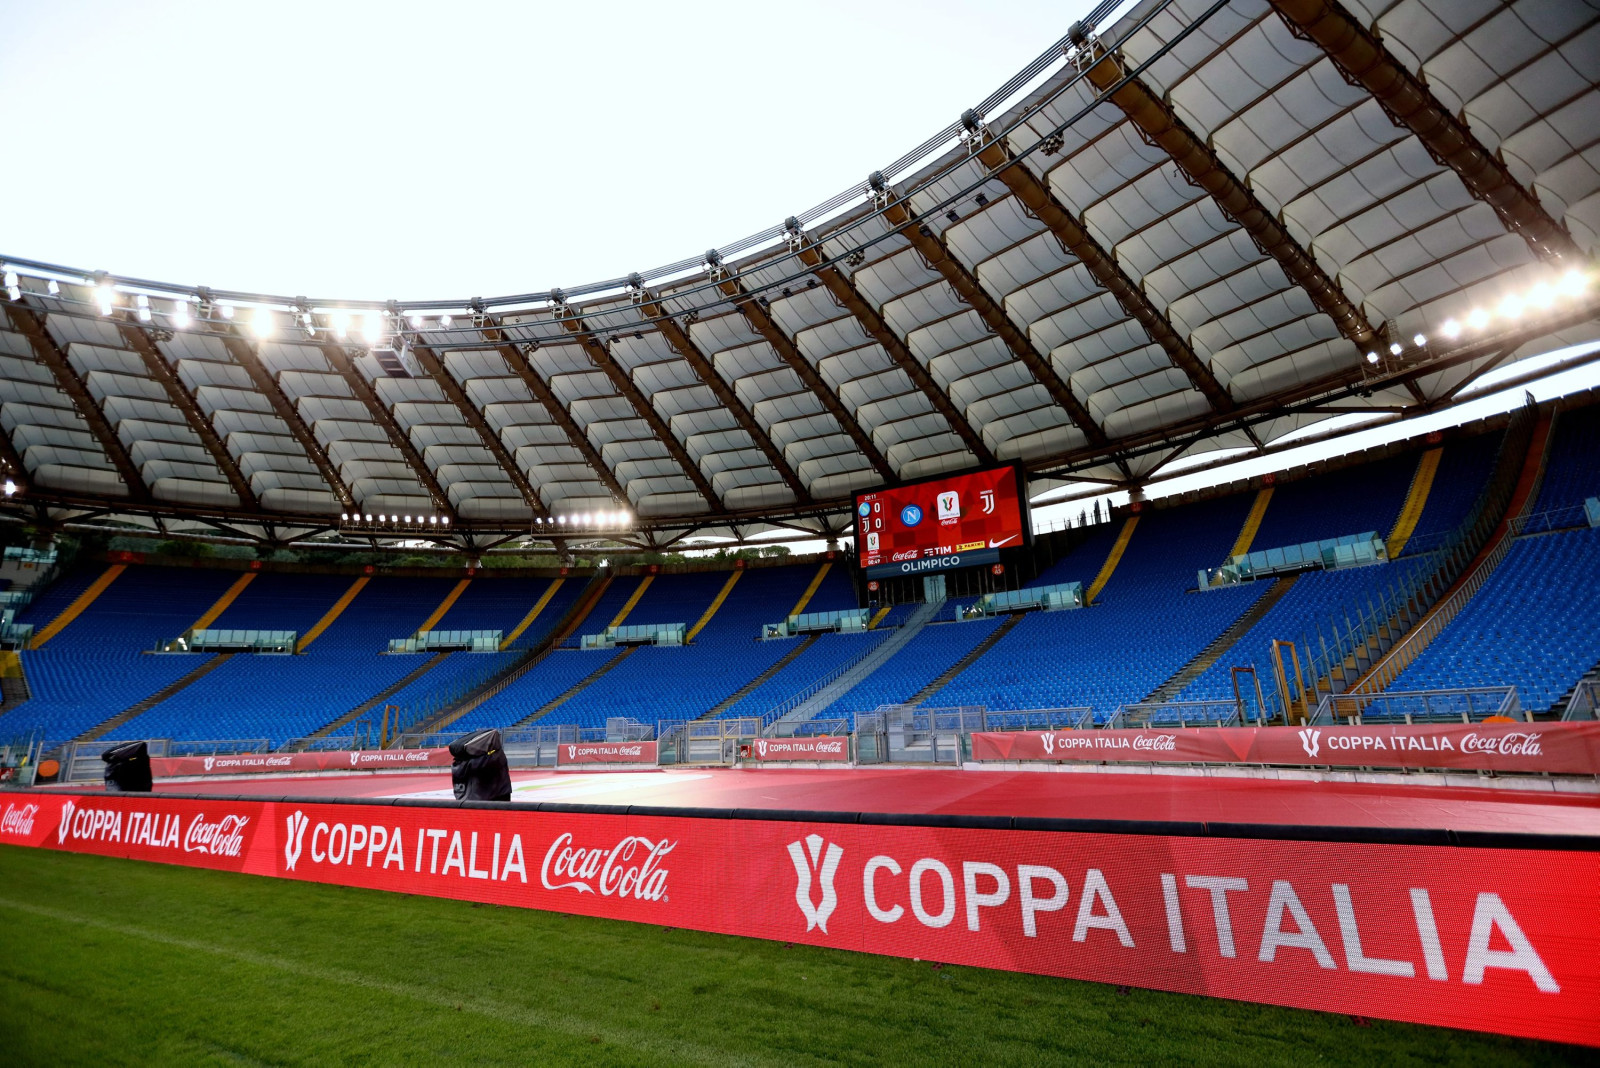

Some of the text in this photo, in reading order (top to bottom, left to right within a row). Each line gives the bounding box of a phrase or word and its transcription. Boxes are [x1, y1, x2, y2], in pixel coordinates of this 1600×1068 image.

[874, 502, 880, 513] 0
[875, 518, 881, 528] 0
[934, 545, 952, 555] TIM
[901, 555, 960, 572] OLIMPICO
[769, 743, 792, 752] COPPA
[793, 743, 814, 751] ITALIA
[1058, 735, 1176, 750] COPPA ITALIA Coca-Cola
[1328, 732, 1543, 756] COPPA ITALIA Coca-Cola
[577, 747, 598, 756] COPPA
[599, 747, 618, 755] ITALIA
[216, 758, 241, 768] COPPA
[242, 758, 265, 766] ITALIA
[360, 754, 383, 762] COPPA
[383, 753, 404, 761] ITALIA
[73, 809, 250, 857] COPPA ITALIA Coca-Cola
[311, 822, 679, 902] COPPA ITALIA Coca-Cola
[862, 854, 1561, 994] COPPA ITALIA
